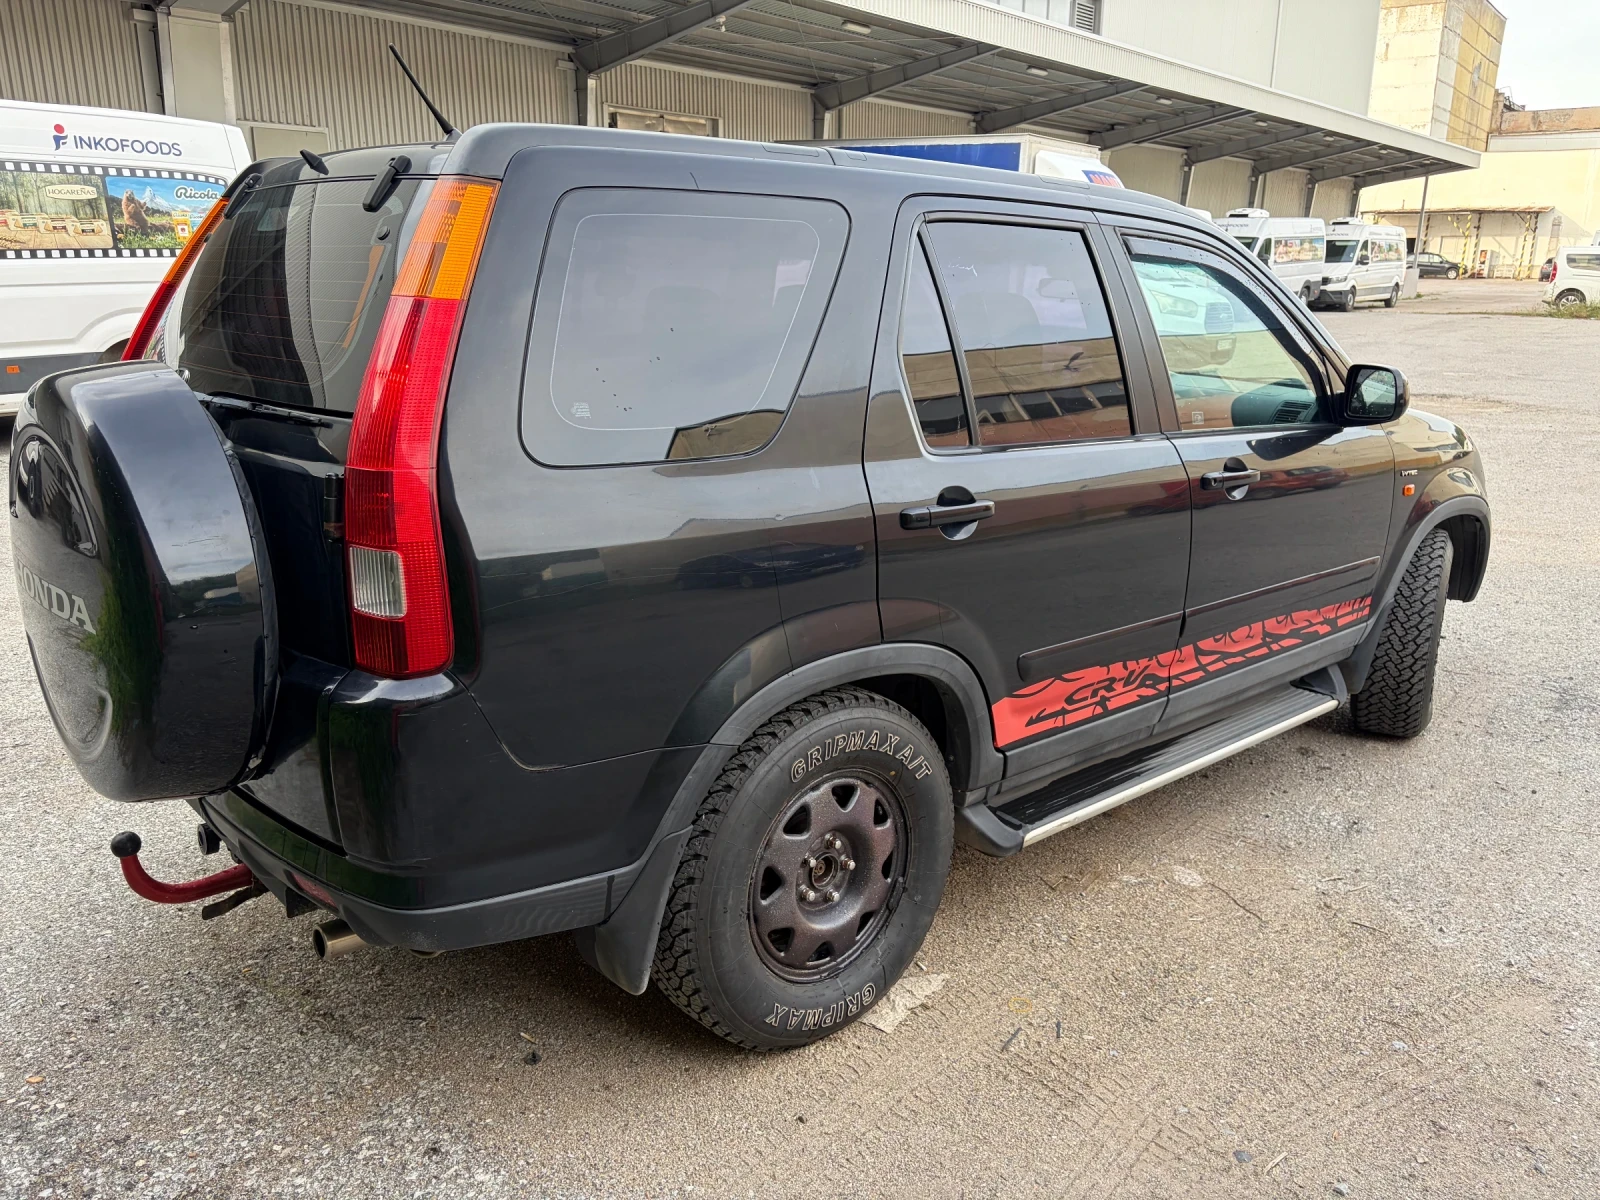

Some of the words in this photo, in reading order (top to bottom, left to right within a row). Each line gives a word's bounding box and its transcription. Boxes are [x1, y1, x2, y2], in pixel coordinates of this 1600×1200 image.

[73, 134, 182, 157] INKOFOODS
[47, 187, 96, 196] HOGAREÑAS
[174, 186, 219, 200] Ricola
[1064, 663, 1152, 706] CR-V
[791, 730, 901, 783] GRIPMAX
[764, 983, 876, 1031] GRIPMAX
